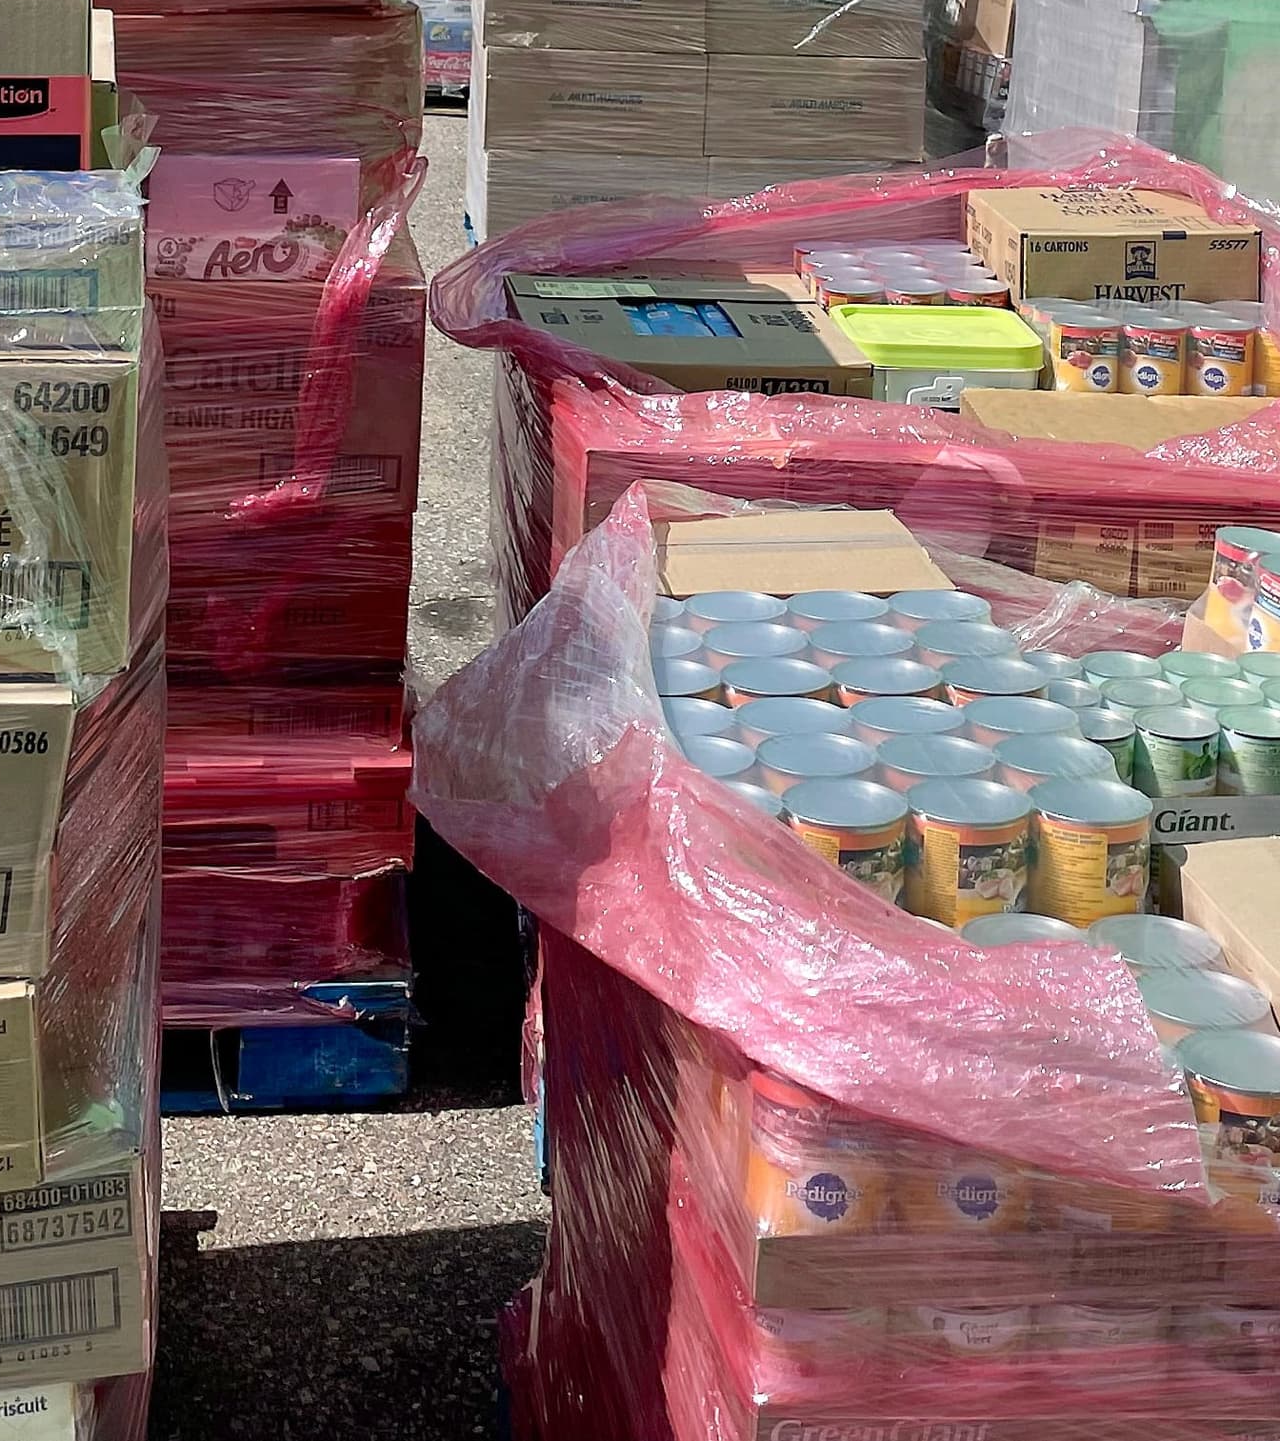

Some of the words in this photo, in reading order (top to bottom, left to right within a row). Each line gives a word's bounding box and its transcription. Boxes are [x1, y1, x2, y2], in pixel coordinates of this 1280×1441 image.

[1030, 241, 1042, 252] 16
[1044, 241, 1088, 252] CARTONS
[1209, 239, 1249, 250] 55577
[204, 240, 300, 279] Aero
[1094, 283, 1186, 303] HARVEST
[14, 381, 111, 414] 64200
[1, 1177, 127, 1213] 68400-01083
[786, 1181, 864, 1205] Pedigree
[6, 1206, 126, 1246] 68737542
